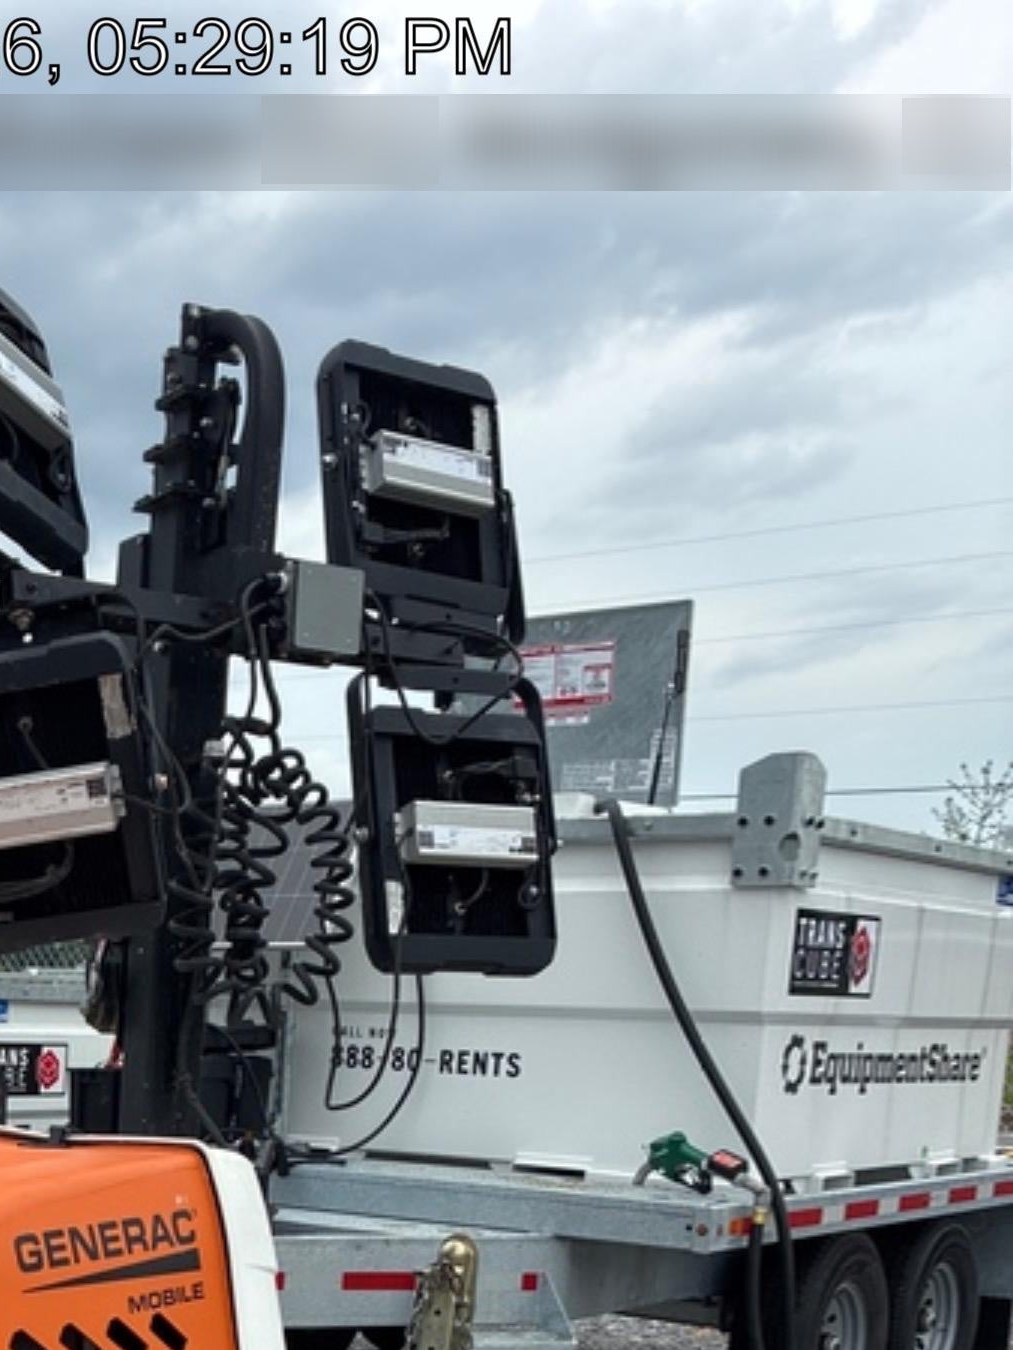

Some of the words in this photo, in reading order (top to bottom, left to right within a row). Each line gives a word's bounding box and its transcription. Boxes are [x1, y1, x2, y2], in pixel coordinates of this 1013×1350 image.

[797, 917, 846, 948] TRANS
[794, 949, 841, 980] CUBE
[809, 1040, 981, 1095] EquipmentShare
[14, 1208, 197, 1274] GENERAC
[128, 1281, 204, 1314] MOBILE
